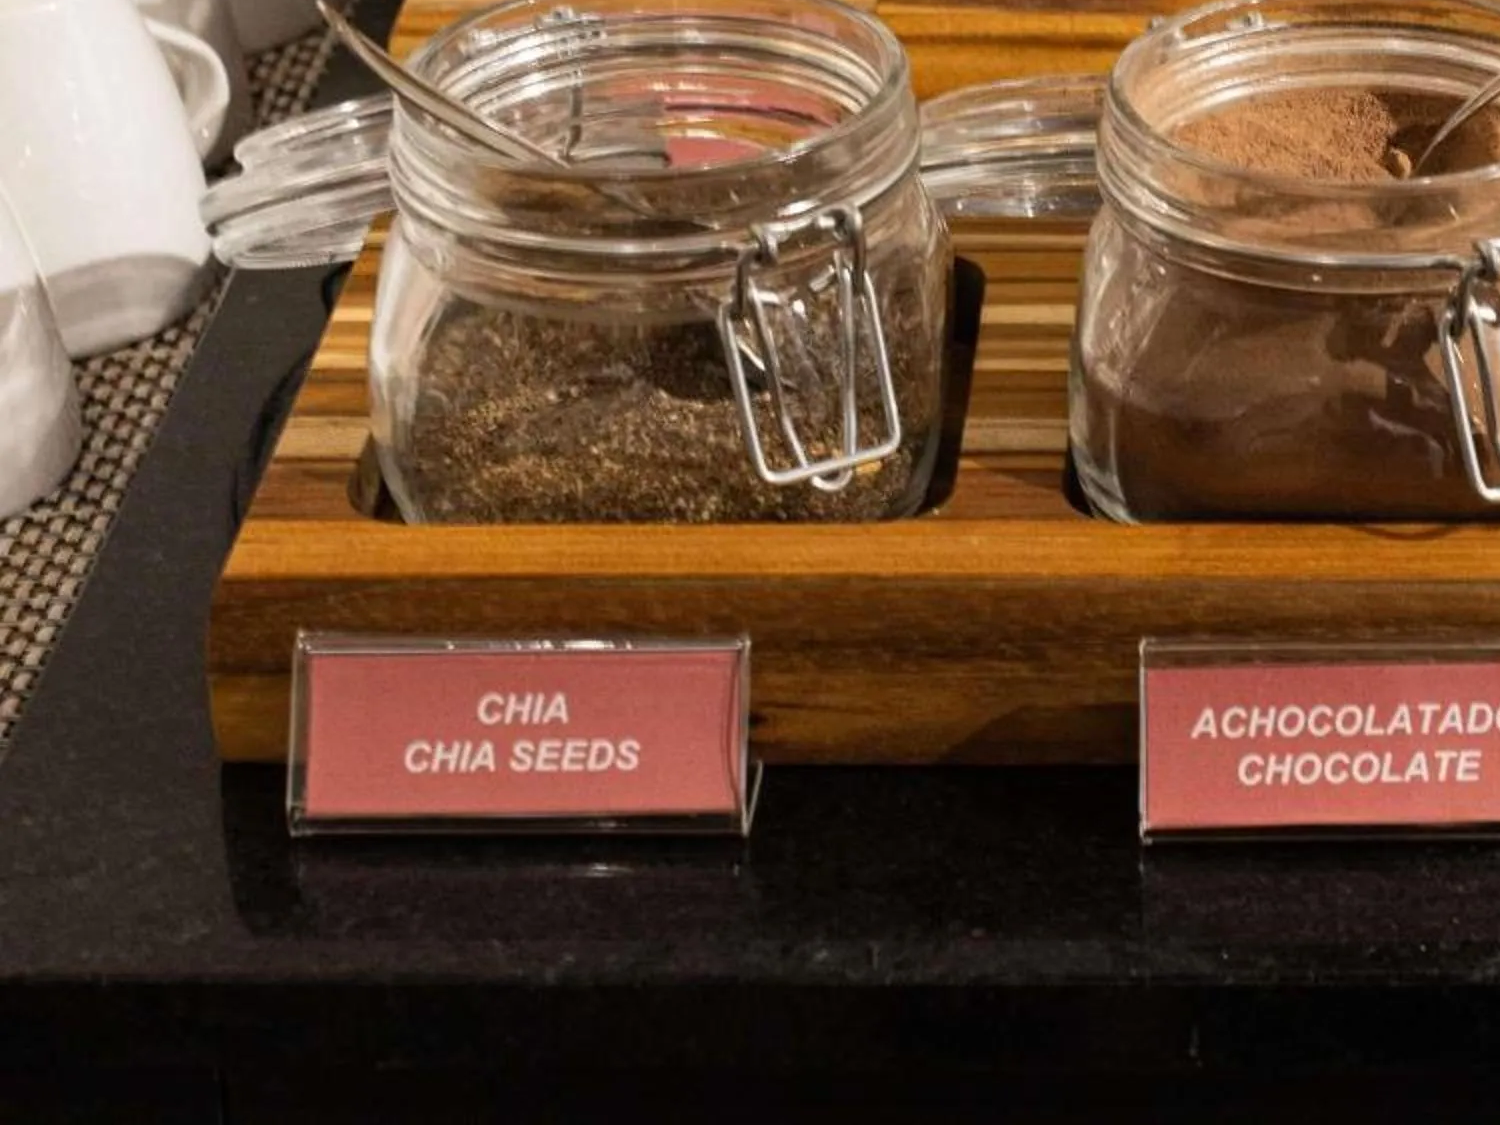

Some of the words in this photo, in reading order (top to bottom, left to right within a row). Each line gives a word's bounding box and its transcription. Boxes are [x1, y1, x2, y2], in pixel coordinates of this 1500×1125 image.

[477, 693, 569, 725] CHIA
[404, 741, 496, 773] CHIA
[509, 739, 641, 772] SEEDS
[1238, 750, 1482, 786] CHOCOLATE
